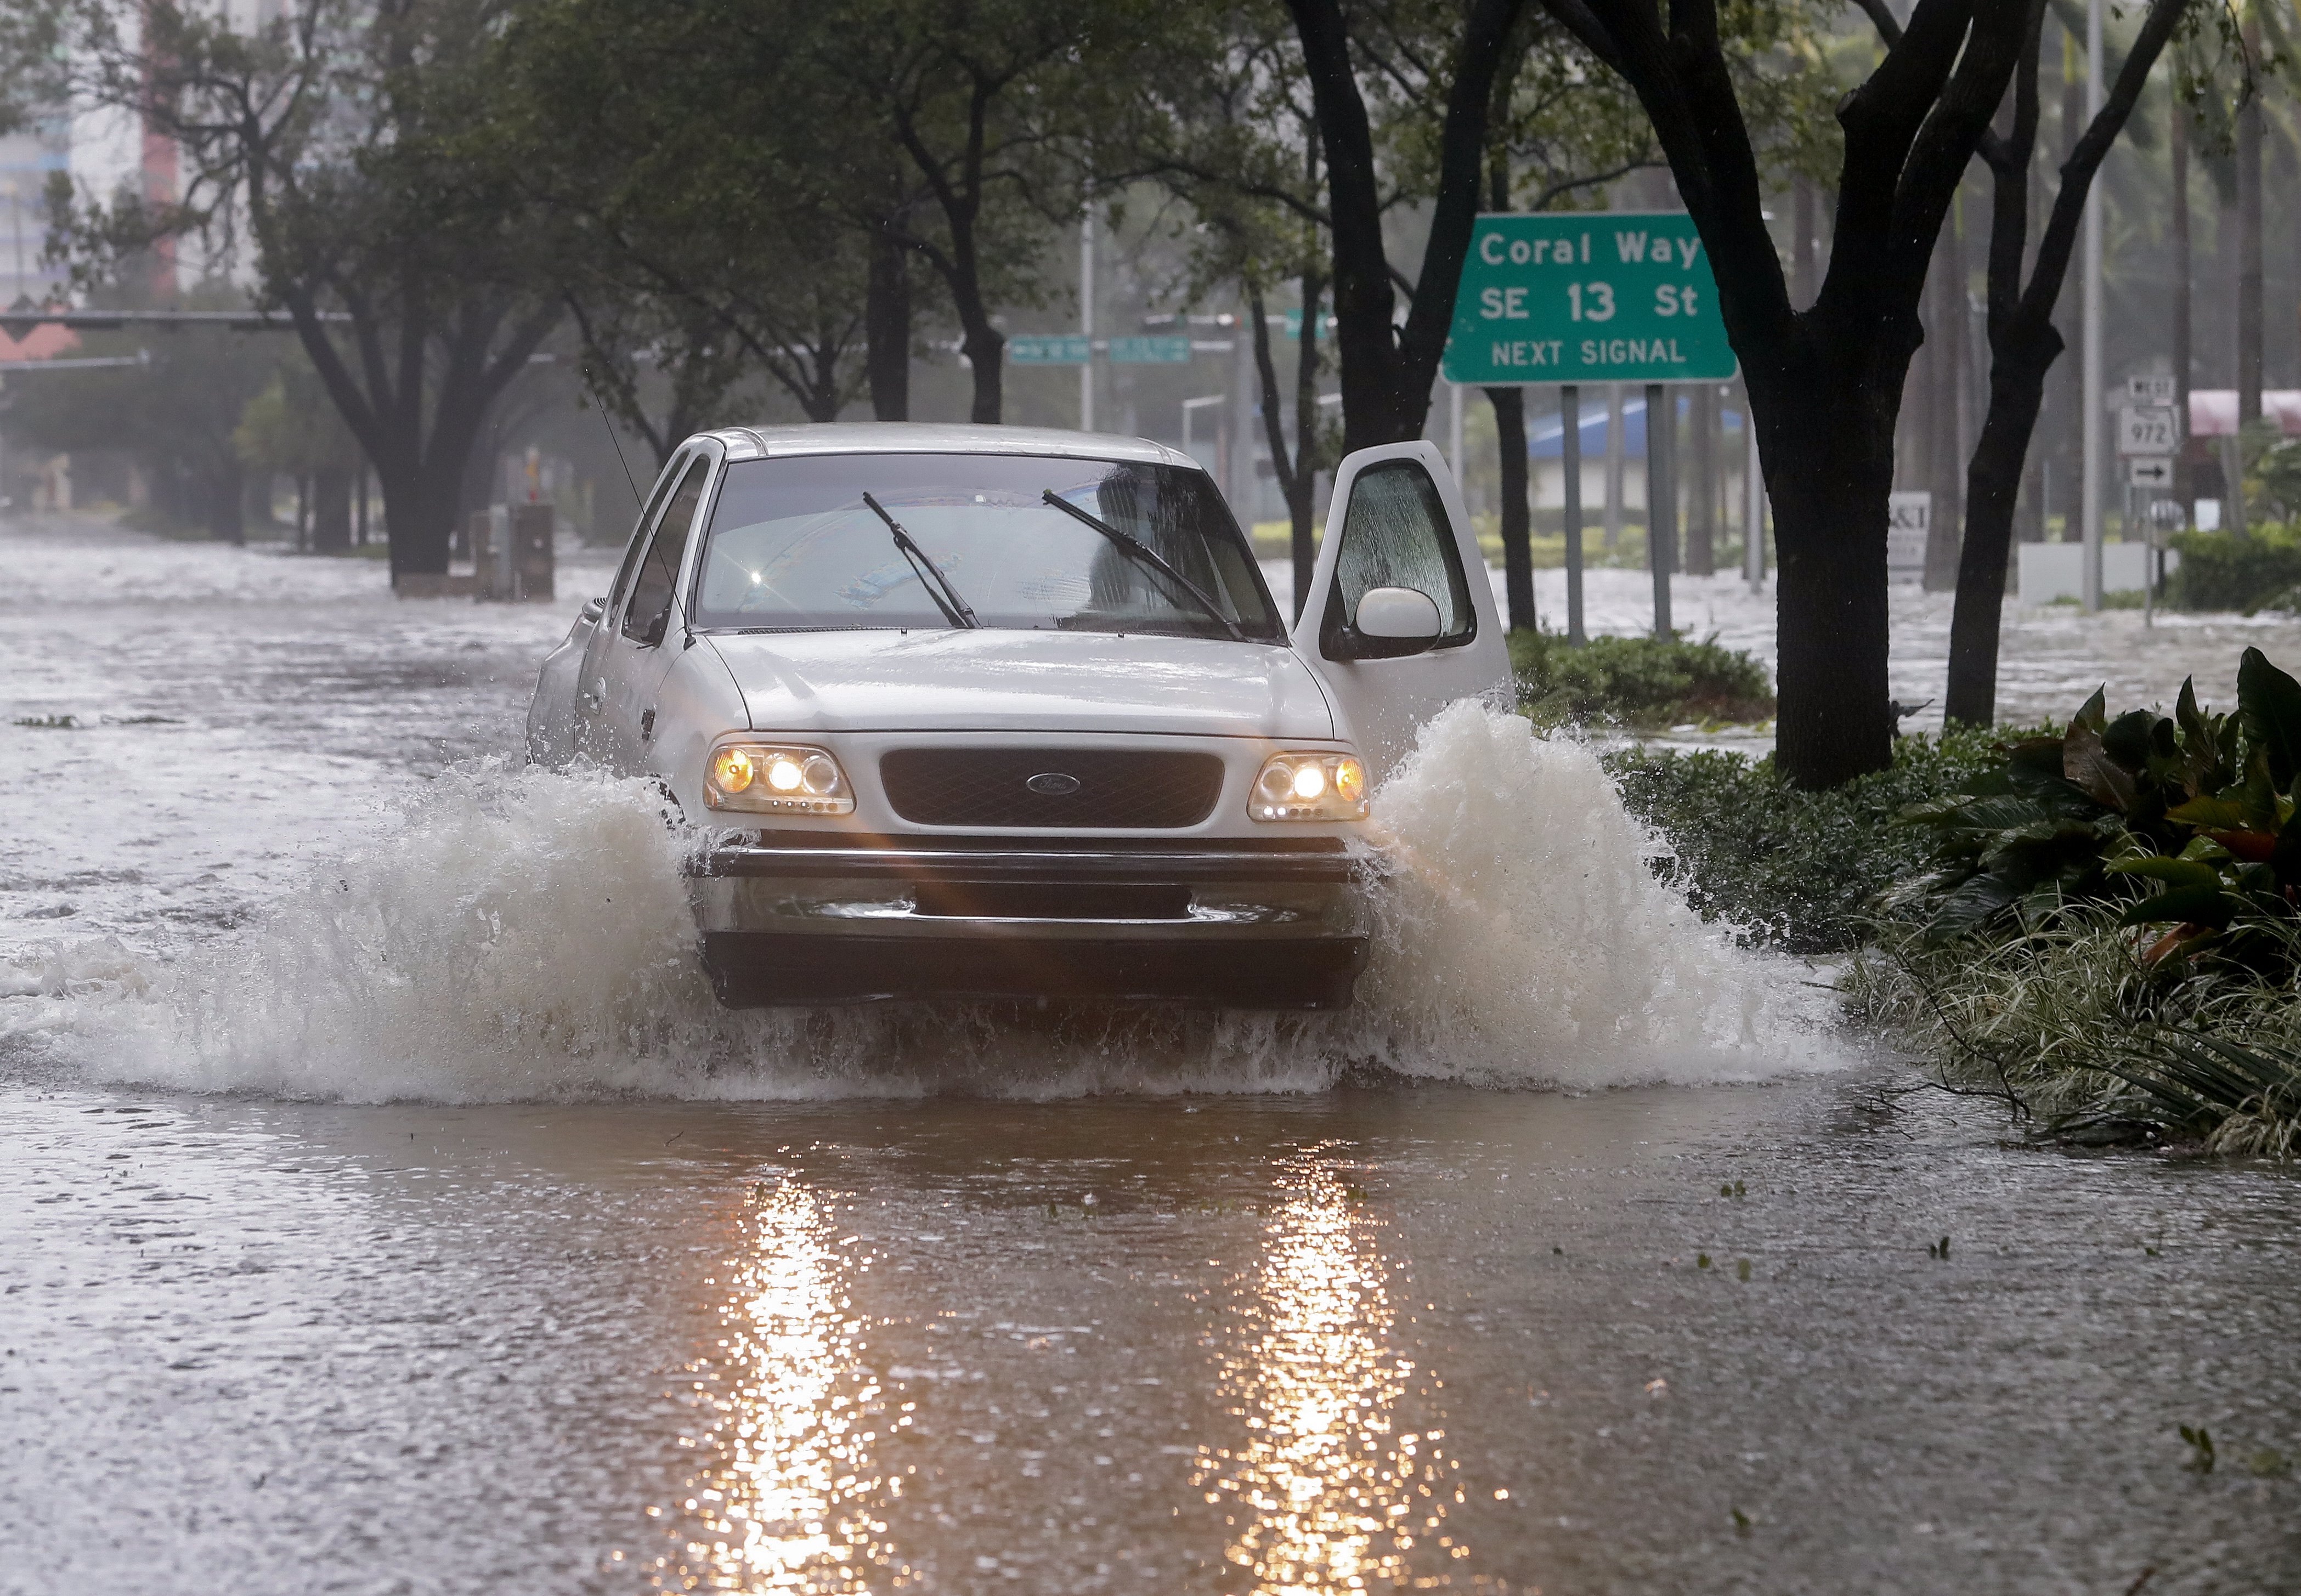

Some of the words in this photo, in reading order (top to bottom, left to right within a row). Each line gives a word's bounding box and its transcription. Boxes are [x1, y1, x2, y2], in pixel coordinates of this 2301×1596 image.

[1480, 232, 1591, 265] Coral
[1615, 231, 1702, 270] Way
[1480, 287, 1530, 320] SE
[1567, 281, 1616, 322] 13
[1654, 284, 1698, 317] St
[1491, 340, 1564, 366] NEXT
[1581, 338, 1686, 365] SIGNAL
[2130, 422, 2166, 444] 972
[1039, 777, 1067, 790] Ford
